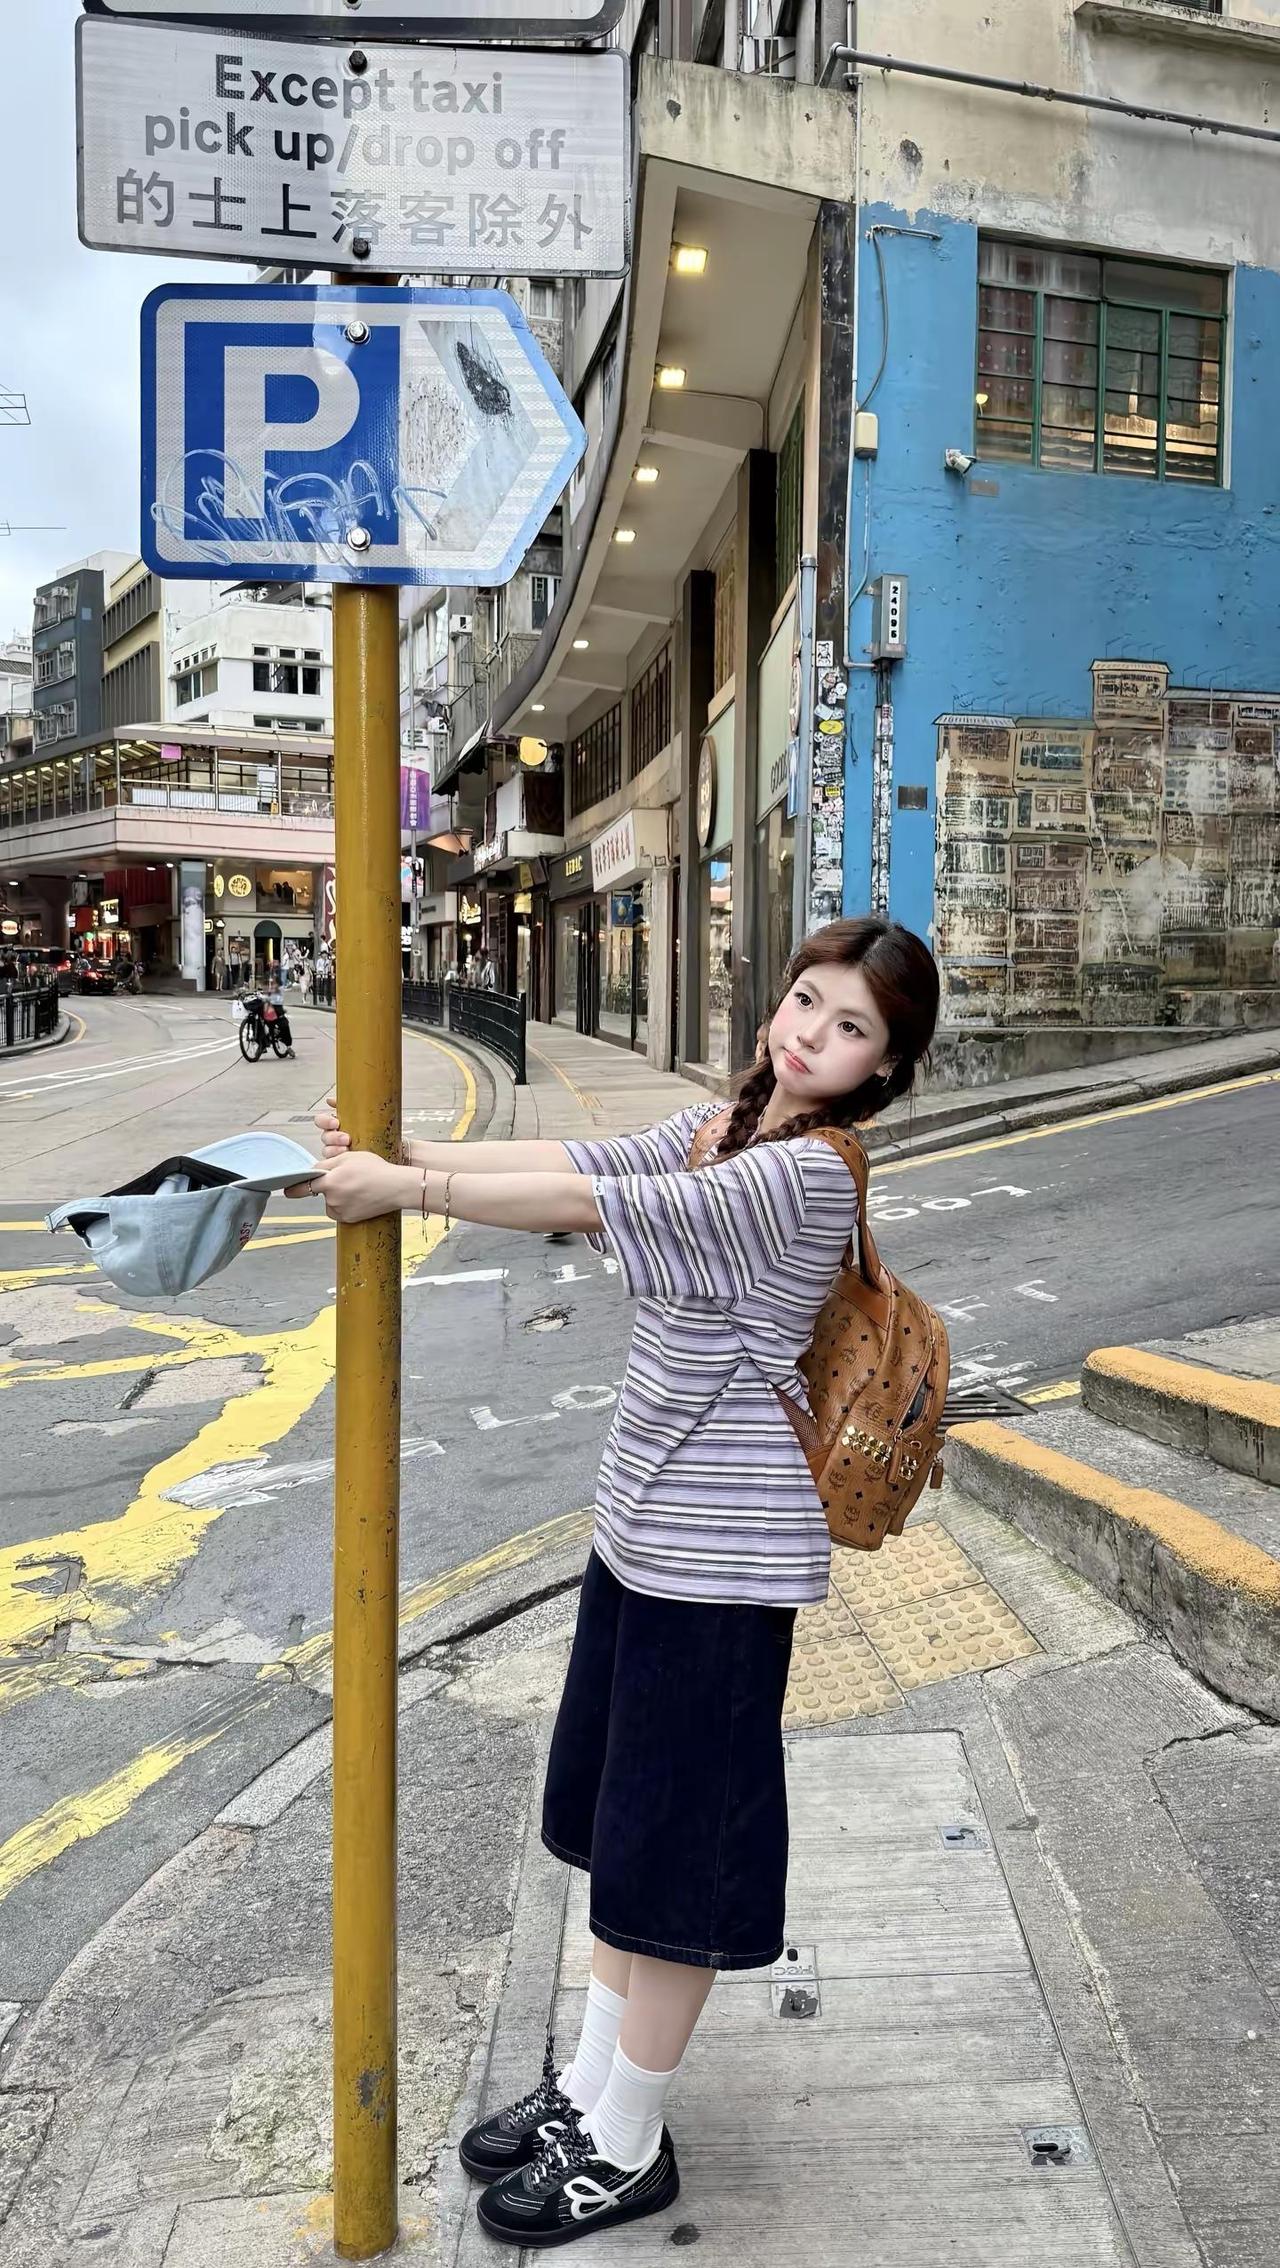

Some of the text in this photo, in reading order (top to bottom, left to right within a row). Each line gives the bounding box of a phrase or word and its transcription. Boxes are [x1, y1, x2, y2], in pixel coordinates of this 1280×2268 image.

[215, 53, 502, 119] Except taxi
[145, 108, 567, 176] pick up/drop off
[116, 169, 592, 250] 的士上落客除外
[224, 346, 360, 518] P
